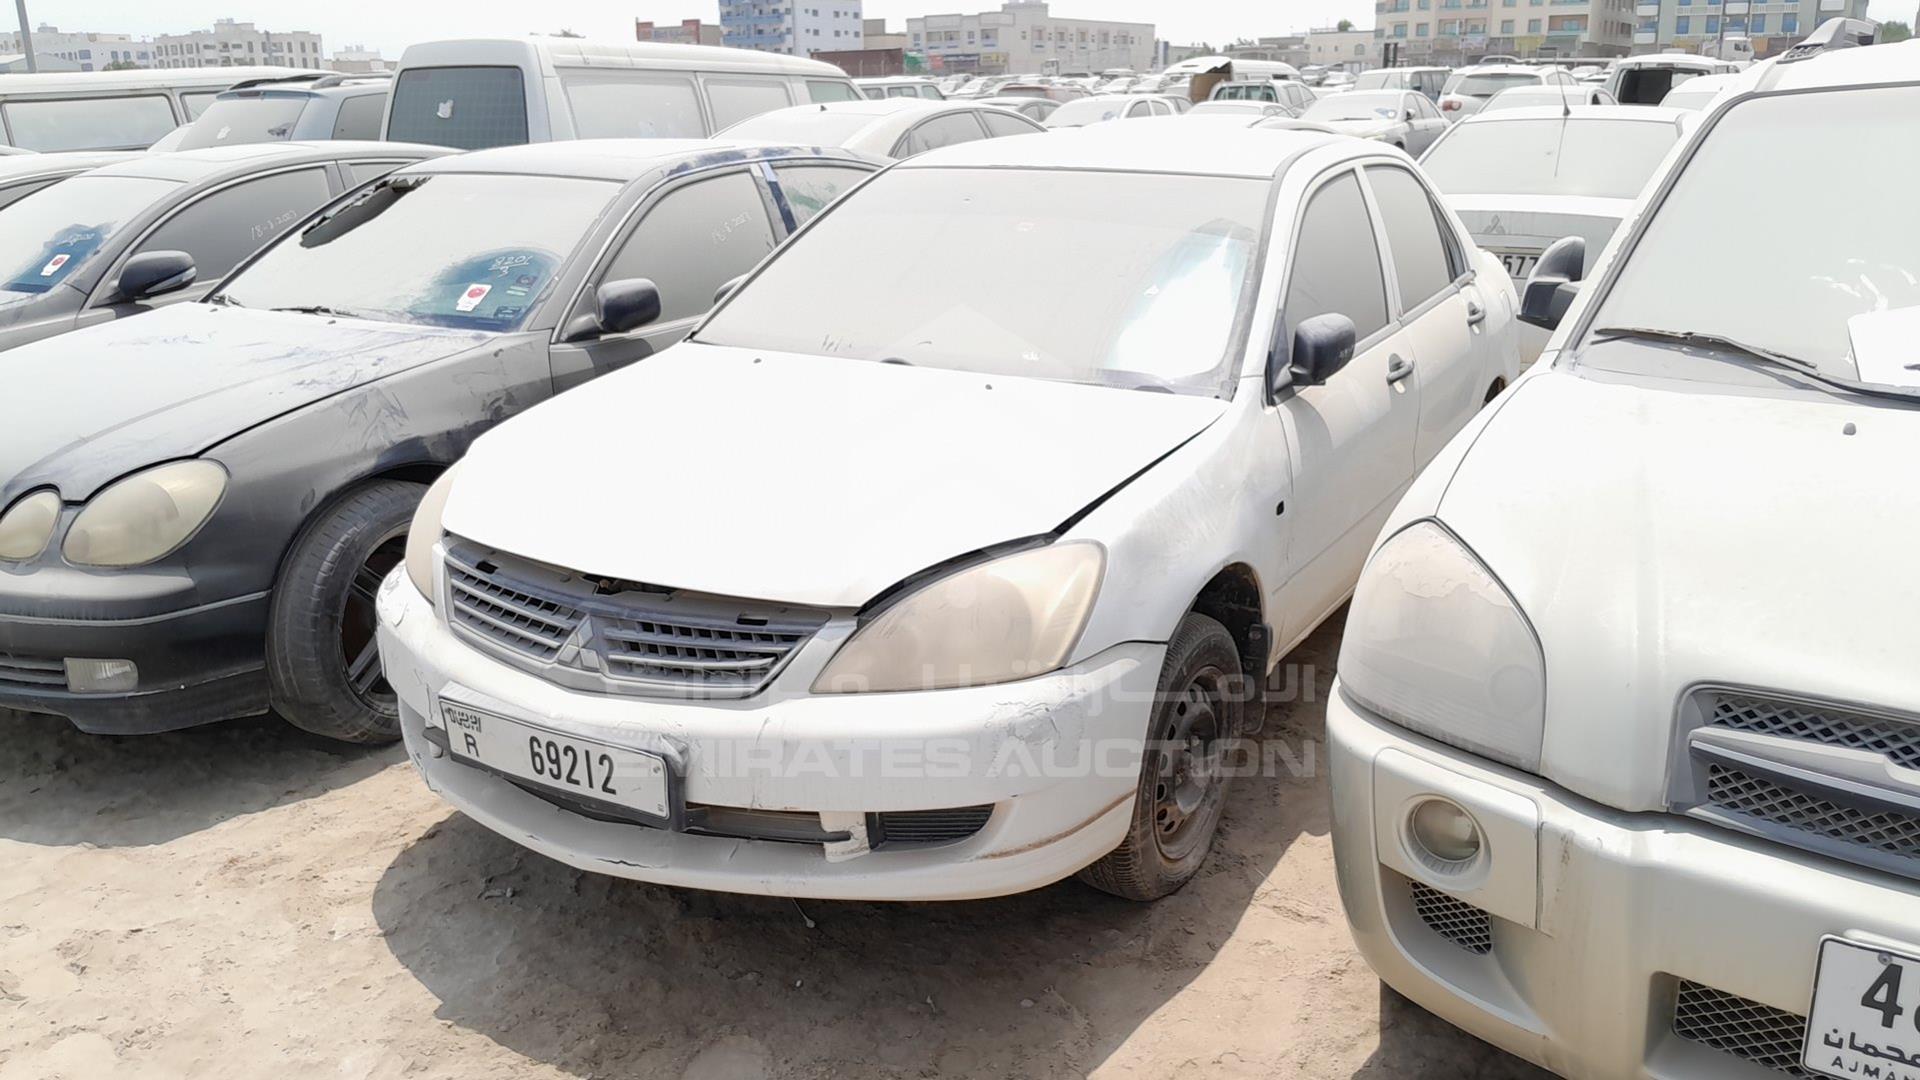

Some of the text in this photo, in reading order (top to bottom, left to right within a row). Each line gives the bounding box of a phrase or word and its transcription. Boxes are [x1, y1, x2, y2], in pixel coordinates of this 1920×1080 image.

[1495, 254, 1540, 276] 577
[463, 732, 617, 796] R 69212
[1860, 962, 1920, 1033] 4
